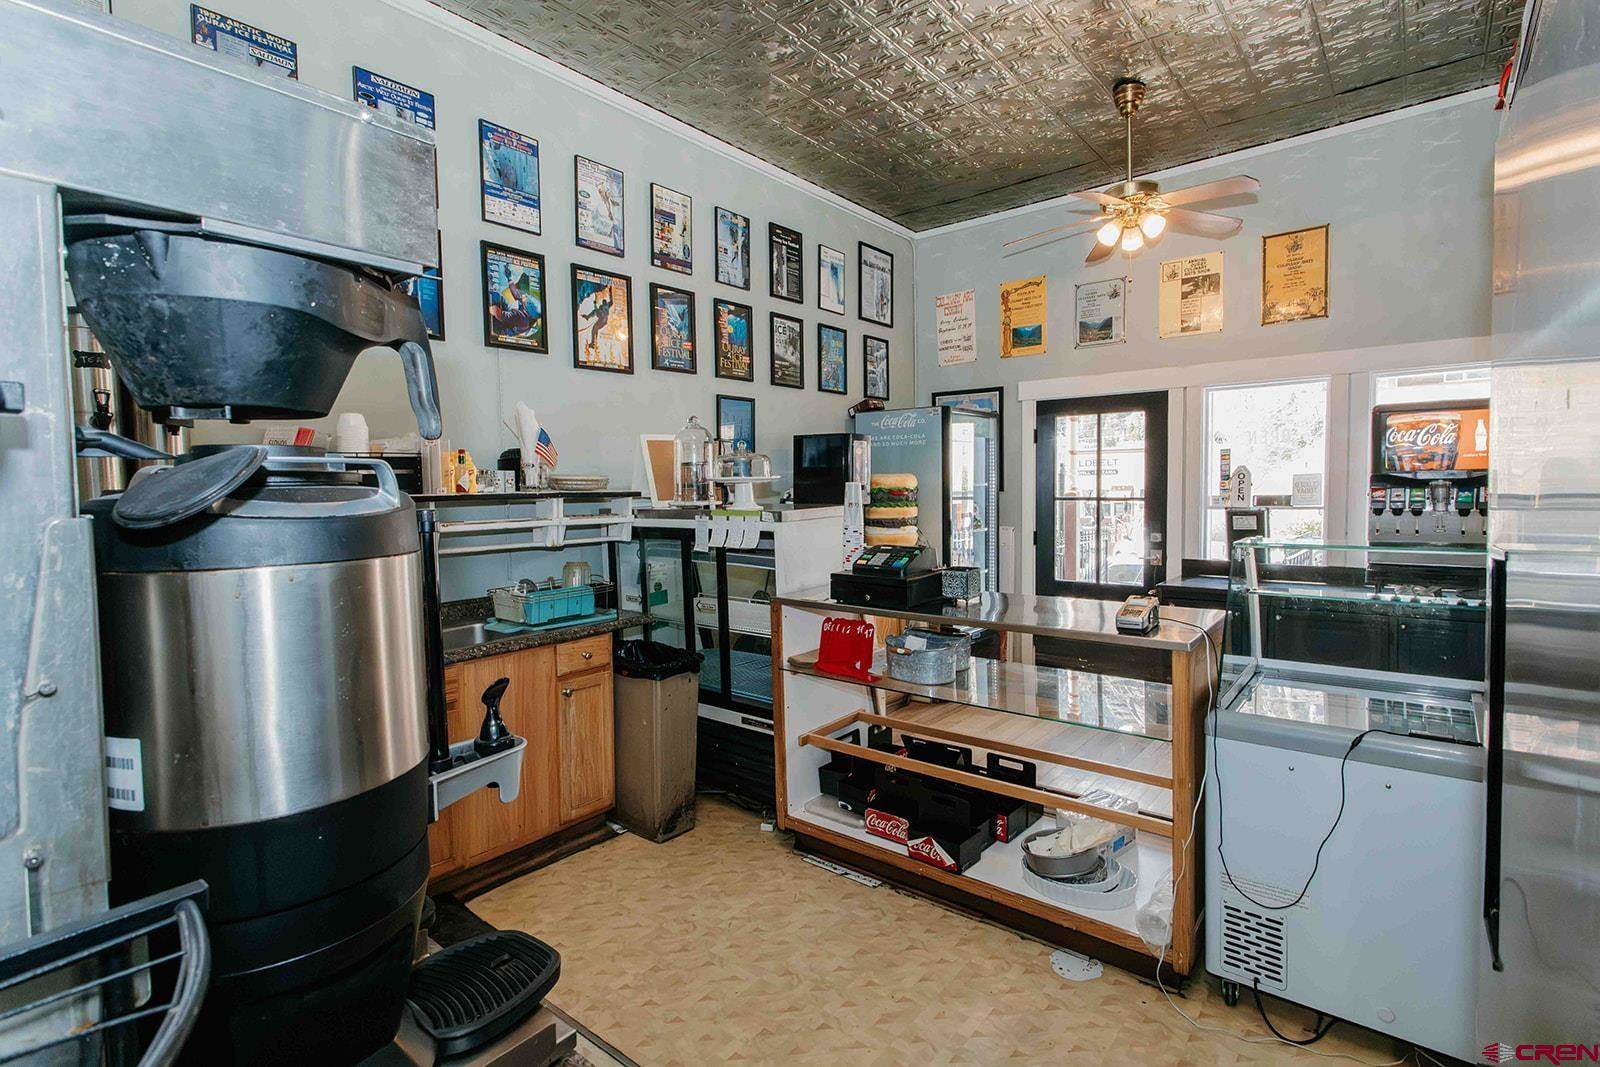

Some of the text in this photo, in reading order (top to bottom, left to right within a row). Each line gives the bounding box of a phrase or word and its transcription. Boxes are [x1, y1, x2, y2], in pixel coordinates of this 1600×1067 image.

[197, 13, 233, 31] OURAY
[234, 27, 250, 39] ICE
[252, 34, 294, 55] FESTIVAL
[226, 19, 261, 37] ARCTIC
[265, 33, 292, 47] WOLF
[880, 412, 917, 429] Coca-Cola
[1386, 423, 1459, 450] Coca-Cola
[866, 813, 906, 840] Coca-Cola
